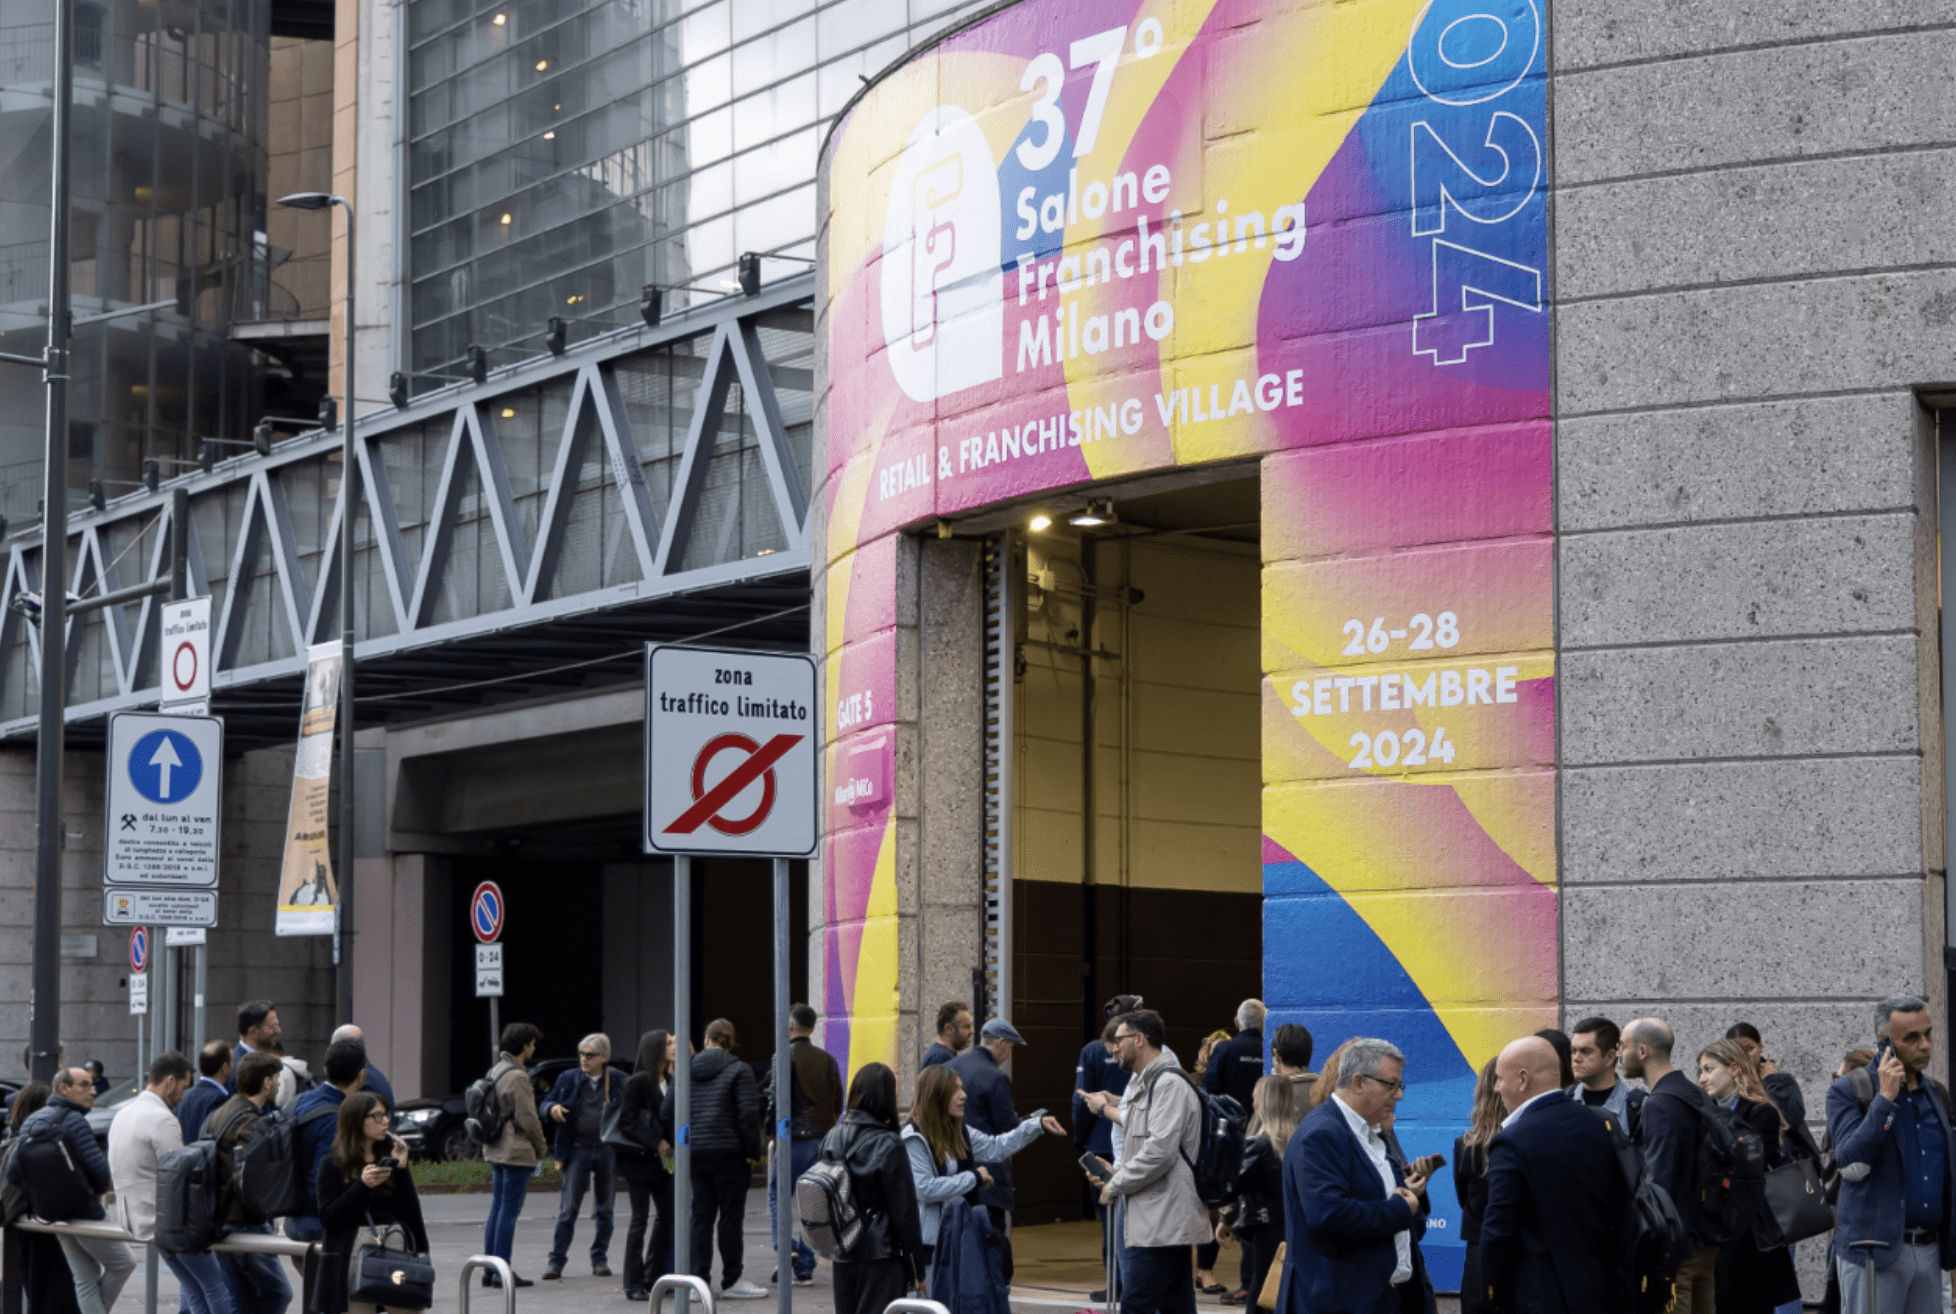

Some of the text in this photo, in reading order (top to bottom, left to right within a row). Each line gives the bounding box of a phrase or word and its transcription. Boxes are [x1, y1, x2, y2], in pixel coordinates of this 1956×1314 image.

[1016, 17, 1164, 171] 37°
[1016, 164, 1171, 241] Salone
[1016, 198, 1307, 306] Franchising
[1016, 300, 1175, 373] Milano
[879, 369, 1304, 501] RETAIL & FRANCHISING VILLAGE
[1341, 611, 1460, 656] 26-28
[715, 668, 753, 685] zona
[1291, 666, 1518, 717] SETTEMBRE
[660, 691, 807, 720] traffico limitato
[838, 690, 872, 730] GATE 5
[1348, 727, 1455, 769] 2024
[142, 813, 158, 821] dal
[161, 813, 178, 822] lun
[181, 814, 190, 823] al
